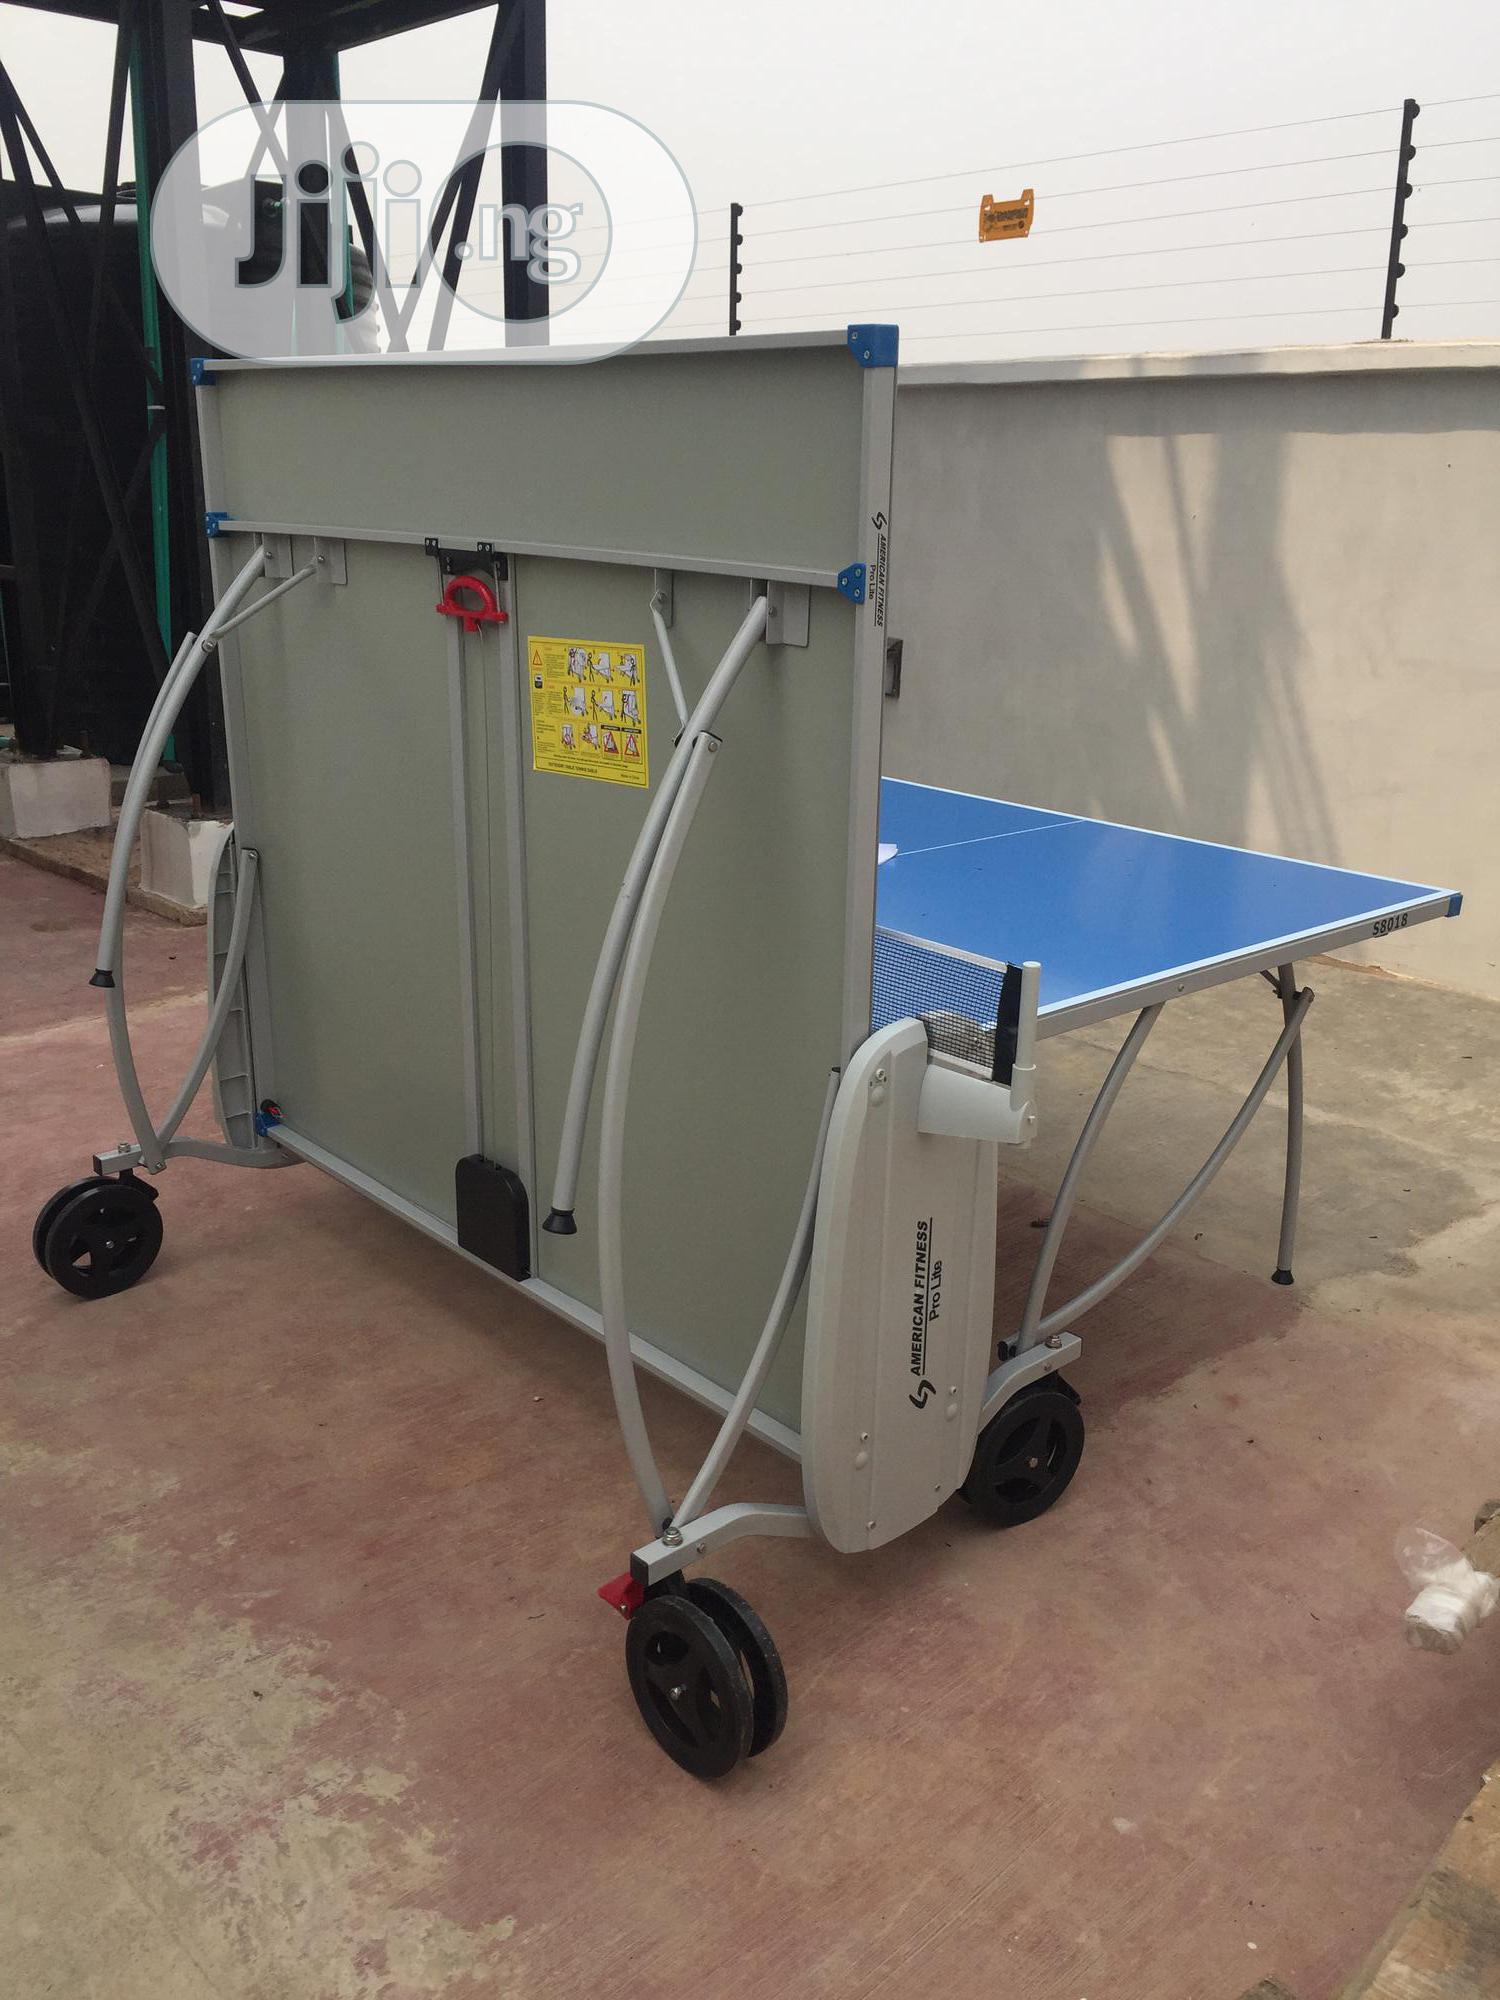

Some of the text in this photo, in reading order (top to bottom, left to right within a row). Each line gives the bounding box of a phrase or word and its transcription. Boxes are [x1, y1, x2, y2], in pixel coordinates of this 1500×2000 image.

[869, 564, 877, 581] Pro
[876, 533, 887, 627] AMERICAN FITNESS
[1372, 912, 1409, 935] S8018
[910, 1220, 928, 1377] AMERICAN FITNESS
[929, 1260, 943, 1322] Pro Lite
